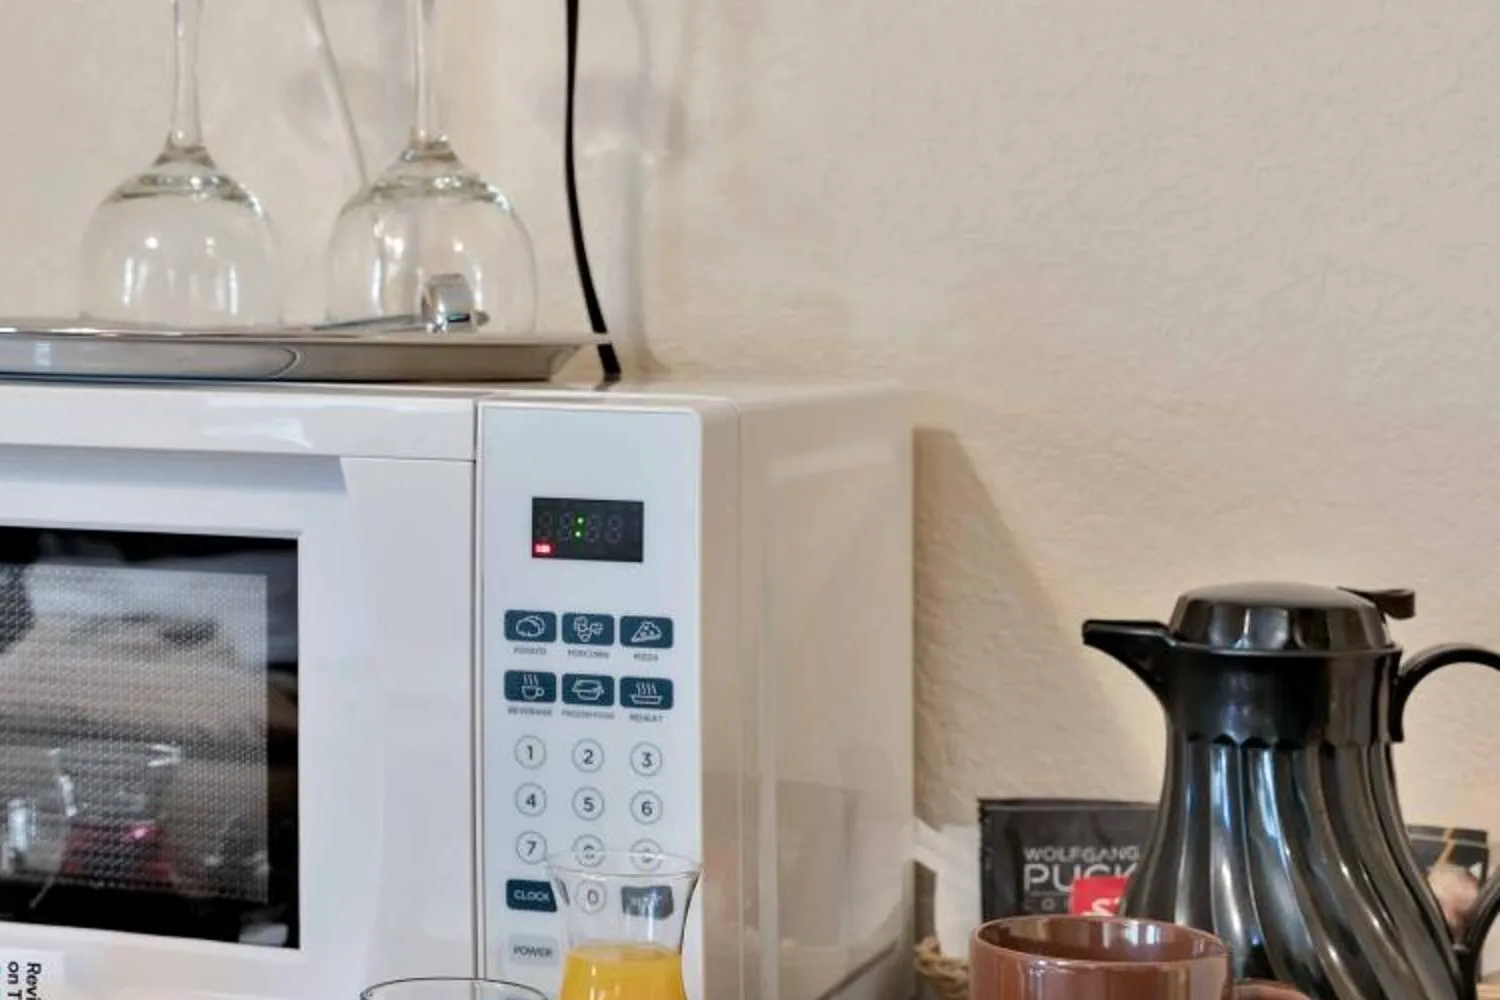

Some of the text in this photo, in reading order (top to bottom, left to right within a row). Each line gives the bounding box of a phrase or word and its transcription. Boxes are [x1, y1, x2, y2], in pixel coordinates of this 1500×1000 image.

[526, 744, 534, 761] 1
[582, 748, 595, 765] 2
[641, 751, 653, 768] 3
[525, 793, 537, 809] 4
[583, 797, 595, 813] 5
[641, 801, 653, 817] 6
[526, 840, 537, 857] 7
[1024, 845, 1140, 862] WOLFGANG
[512, 888, 551, 901] CLOCK
[513, 945, 554, 958] POWER
[7, 961, 20, 985] on
